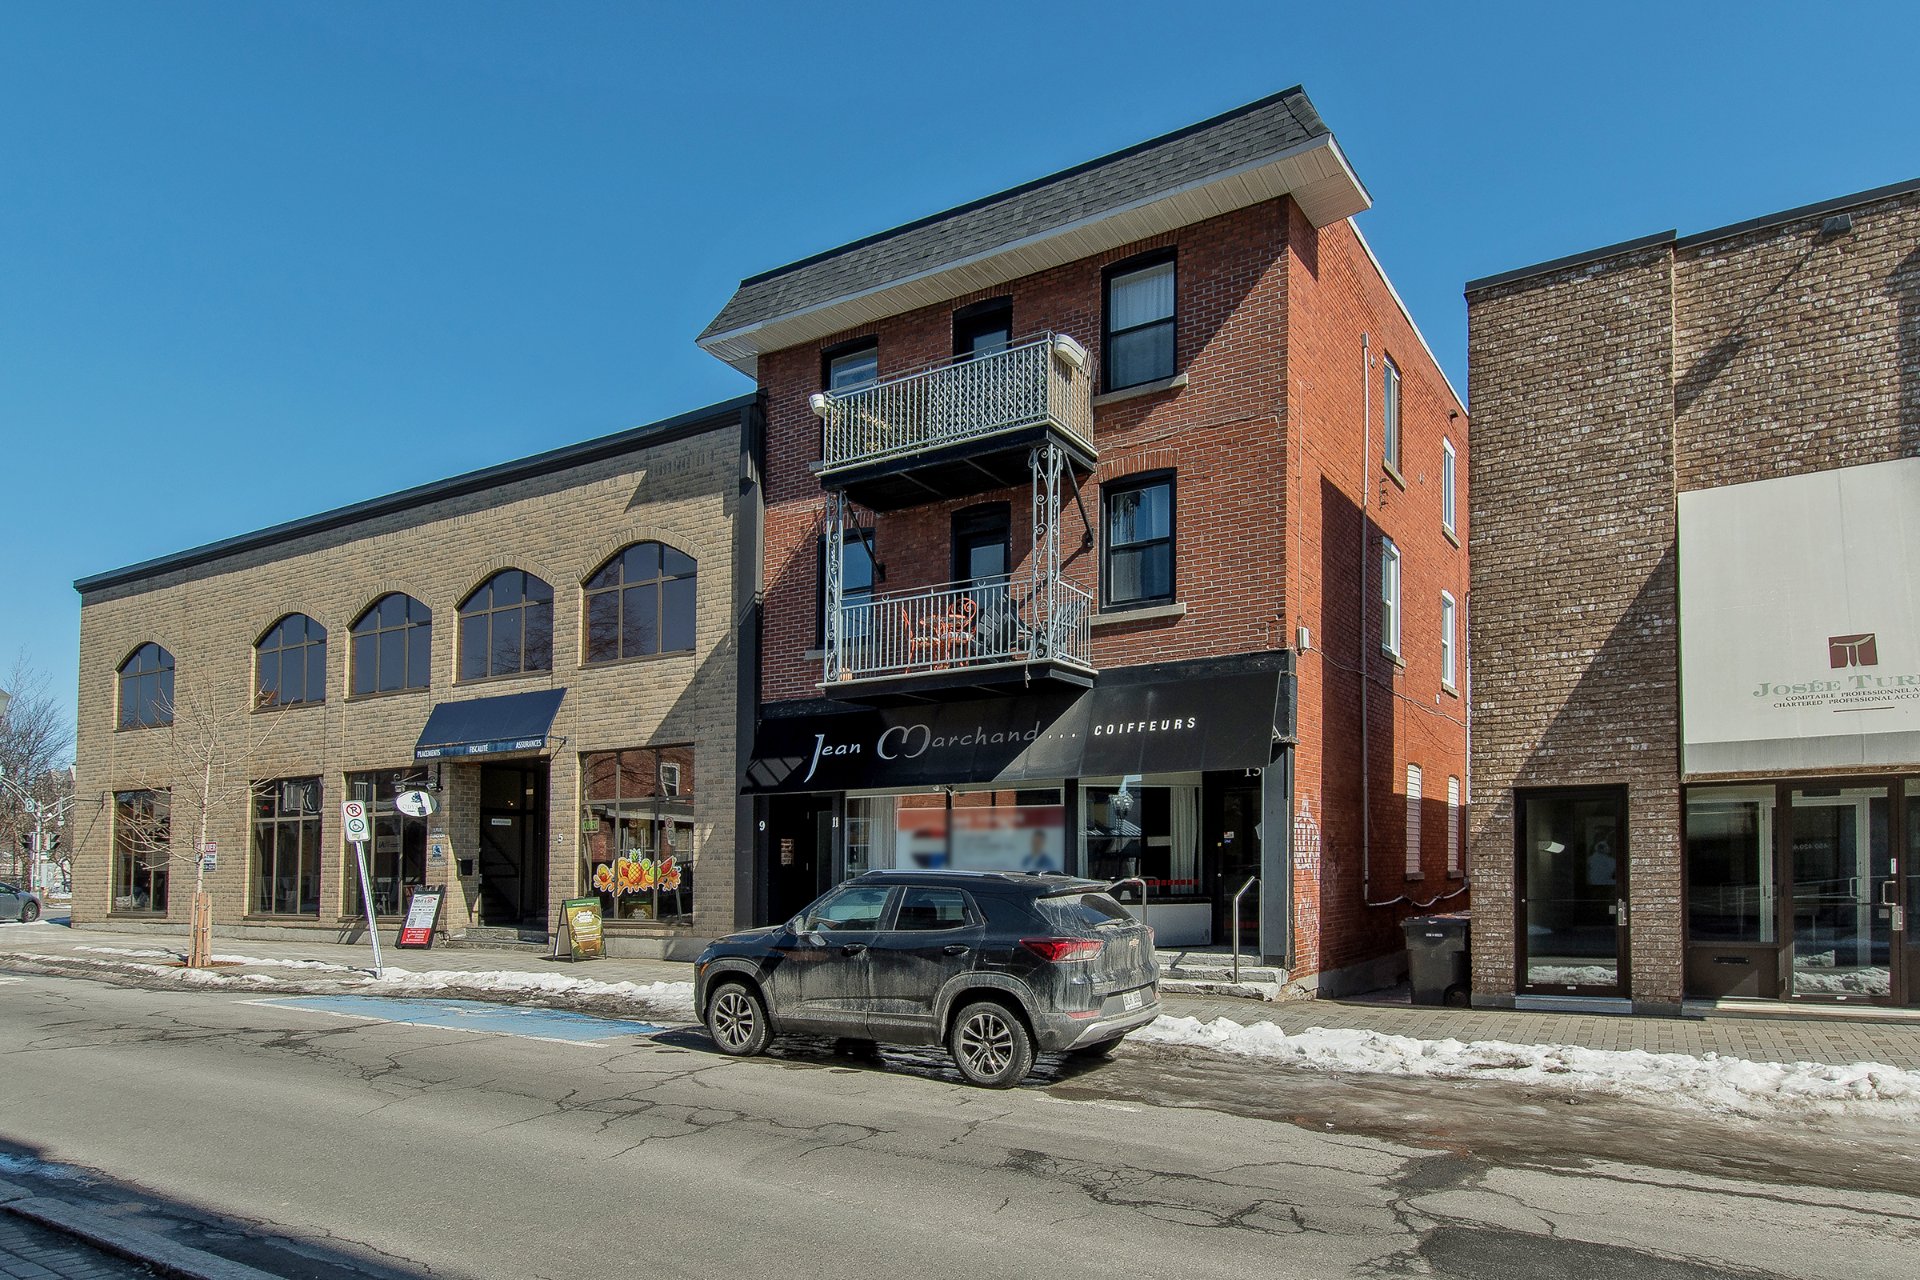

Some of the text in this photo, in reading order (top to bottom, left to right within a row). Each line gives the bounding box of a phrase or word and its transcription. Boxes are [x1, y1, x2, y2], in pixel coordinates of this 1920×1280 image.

[1752, 679, 1841, 697] JOSÉE
[1785, 693, 1836, 701] COMPTABLE
[1841, 687, 1911, 697] PROFESSIONNEL
[1773, 700, 1823, 708] CHARTERED
[1828, 696, 1892, 705] PROFESSIONAL
[515, 739, 542, 749] ASSURANCES
[803, 734, 861, 783] Jean
[1094, 717, 1197, 736] COIFFEURS
[759, 820, 766, 831] 9
[832, 816, 839, 828] 11
[557, 833, 564, 844] 5
